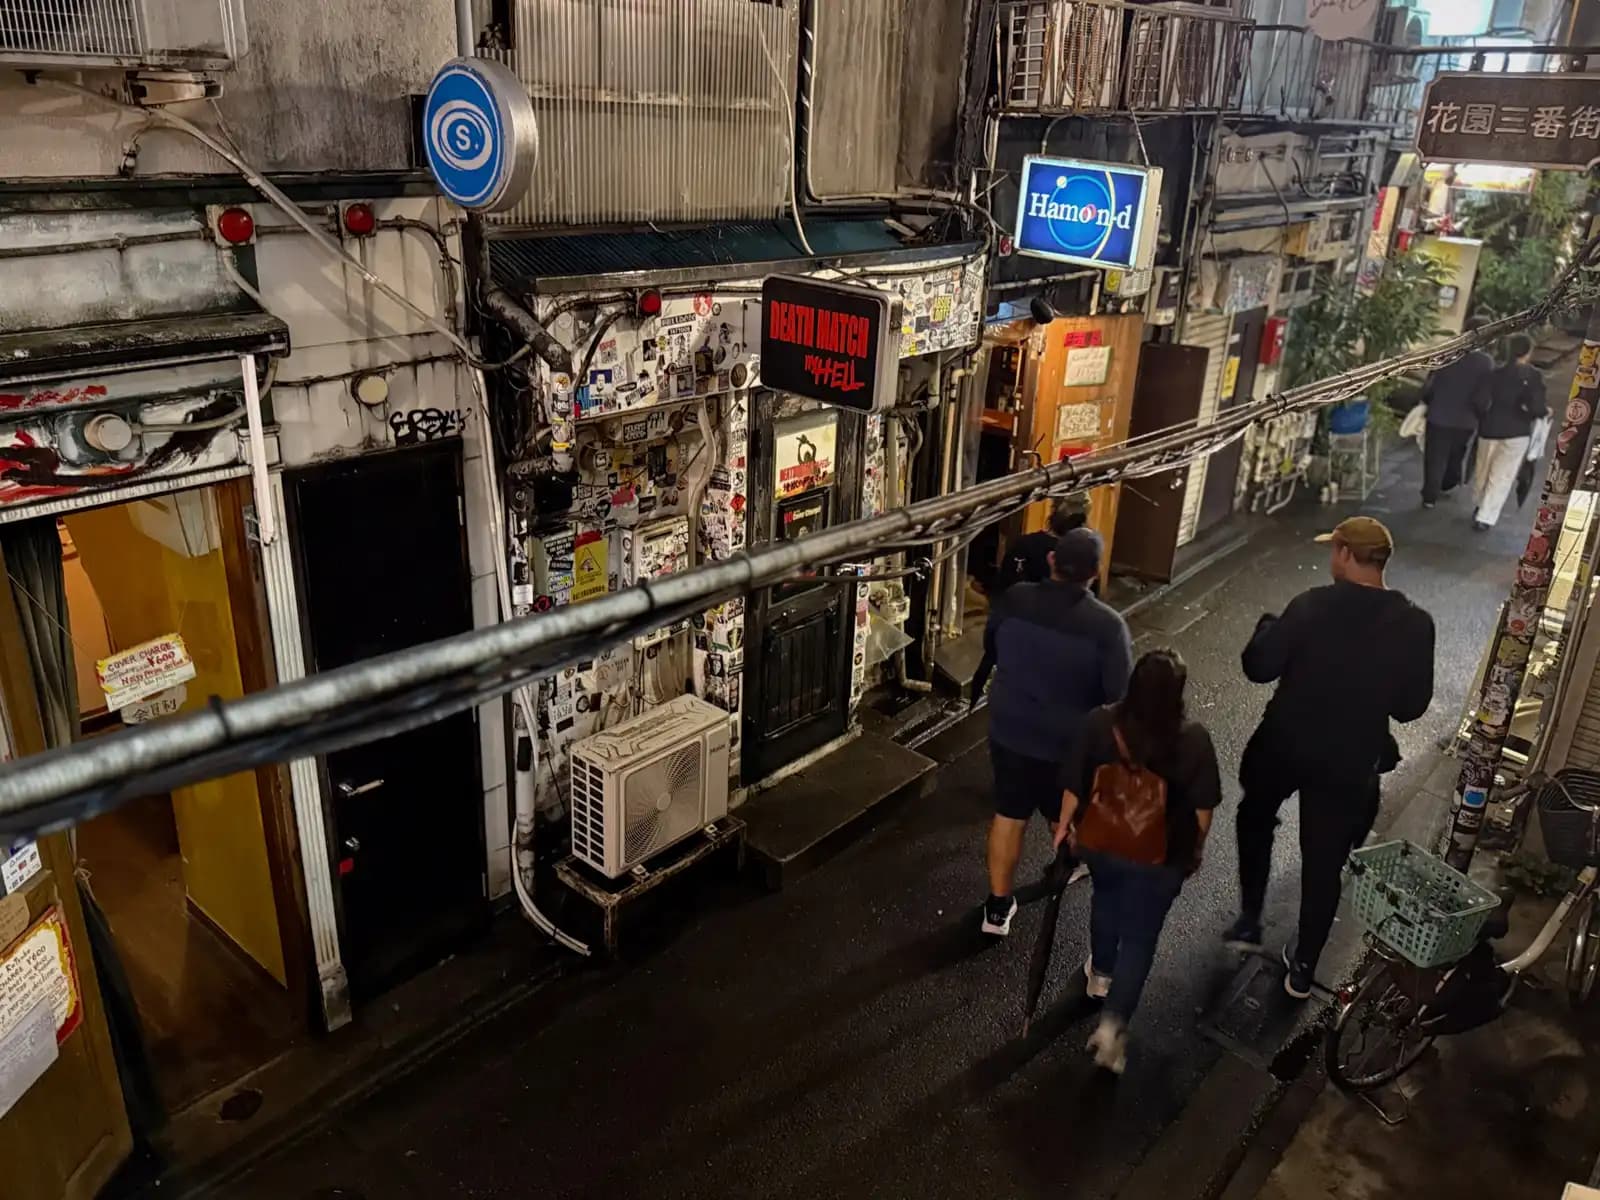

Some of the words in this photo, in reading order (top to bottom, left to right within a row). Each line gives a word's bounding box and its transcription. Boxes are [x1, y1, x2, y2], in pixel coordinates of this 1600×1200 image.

[1426, 101, 1600, 140] 花園三番街
[770, 300, 815, 348] DEATH
[816, 309, 870, 359] MATCH
[812, 357, 865, 392] HELL
[107, 655, 137, 672] COVER
[146, 650, 176, 667] ¥600
